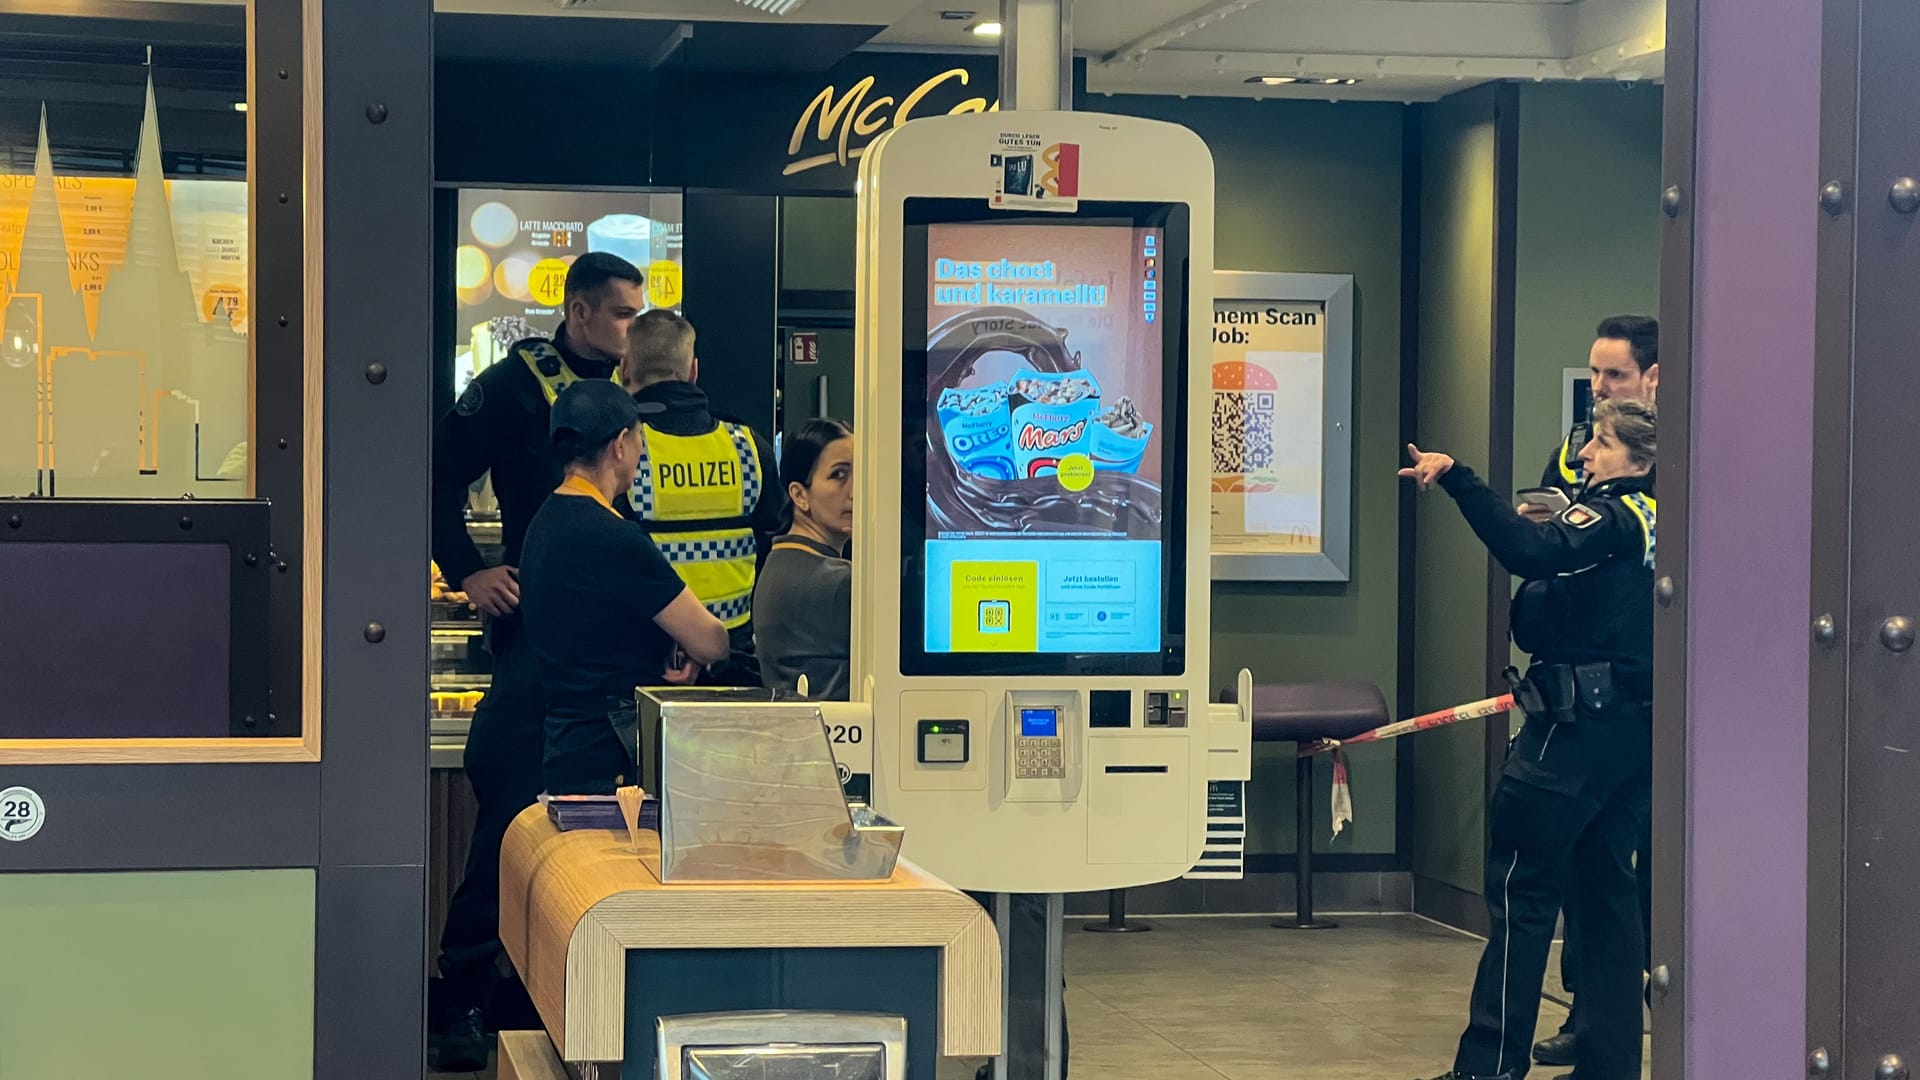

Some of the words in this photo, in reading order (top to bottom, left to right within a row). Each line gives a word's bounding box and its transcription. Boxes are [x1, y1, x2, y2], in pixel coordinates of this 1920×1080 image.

[520, 221, 541, 231] LATTE
[543, 222, 584, 232] MACCHIATO
[937, 258, 983, 280] Das
[986, 258, 1053, 280] choct
[540, 274, 552, 298] 4
[936, 284, 981, 304] und
[987, 283, 1105, 305] karamellt!
[1265, 308, 1317, 326] Scan
[1212, 327, 1250, 345] Job:
[953, 424, 1009, 451] OREO
[1019, 421, 1085, 450] Mars
[659, 461, 736, 488] POLIZEI
[1085, 575, 1119, 583] bestellen
[4, 801, 31, 817] 28
